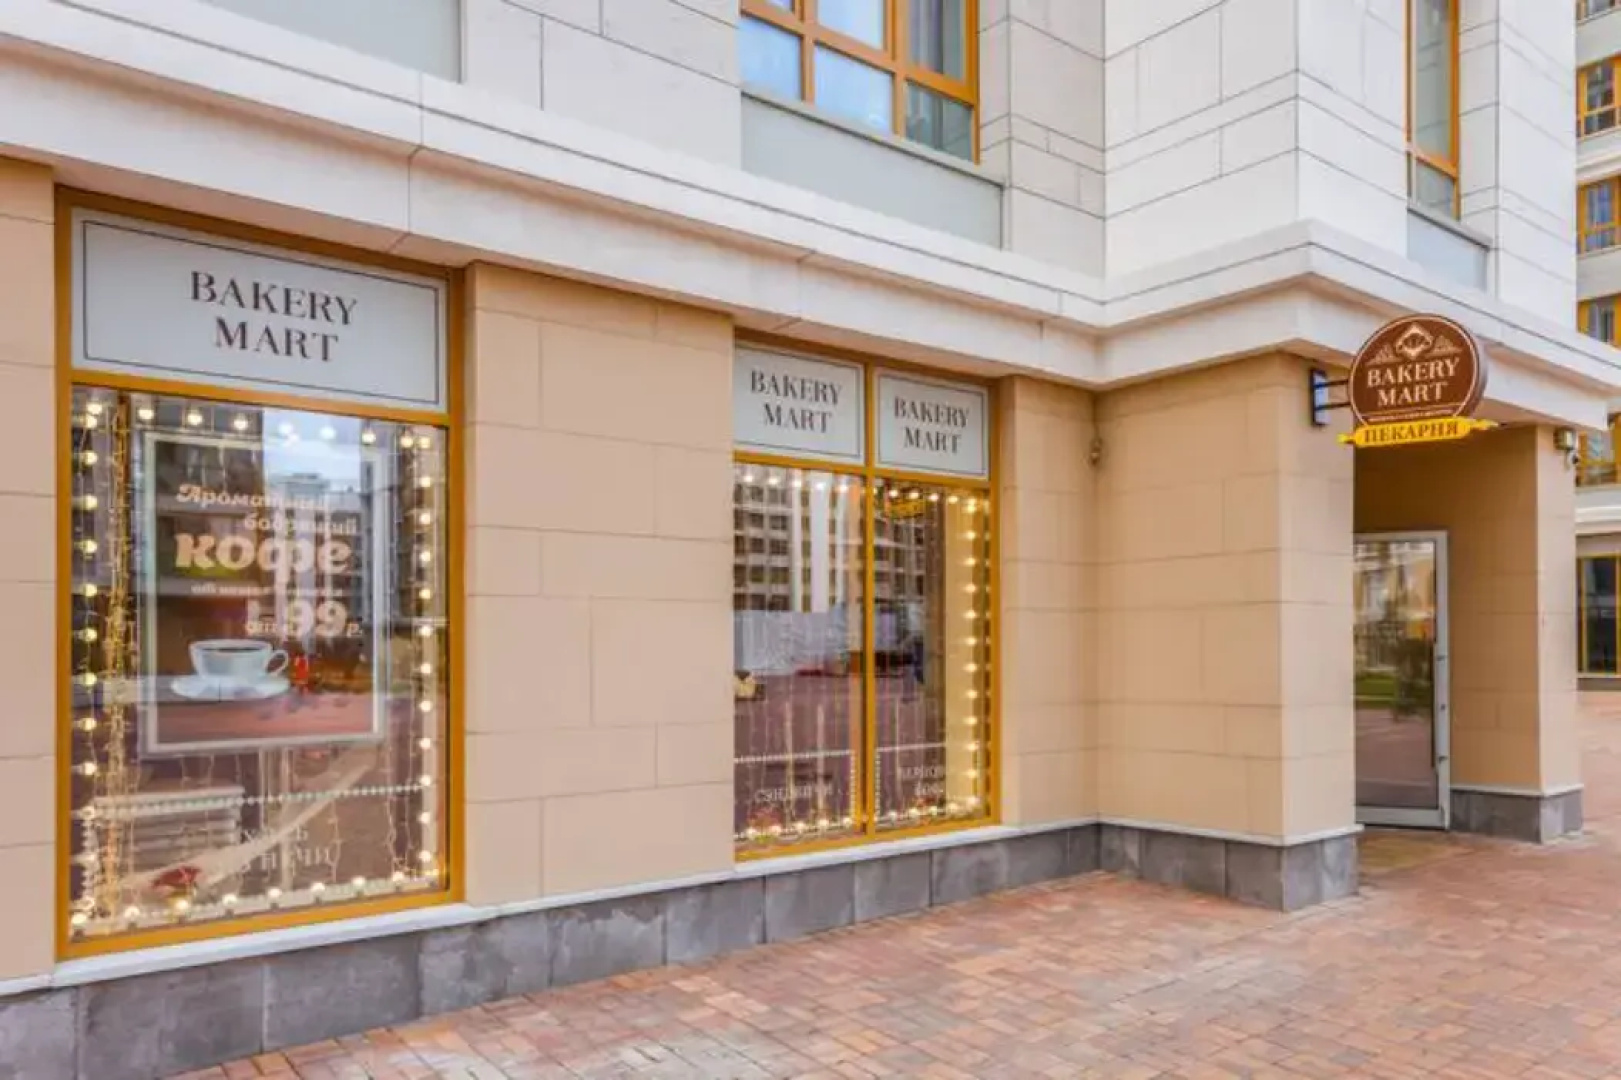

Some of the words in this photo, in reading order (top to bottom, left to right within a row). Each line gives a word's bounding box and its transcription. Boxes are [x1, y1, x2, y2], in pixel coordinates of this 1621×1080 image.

[190, 270, 358, 326] BAKERY
[214, 316, 339, 363] MART
[750, 369, 842, 406] BAKERY
[1367, 357, 1460, 388] BAKERY
[1377, 381, 1449, 407] MART
[763, 402, 833, 434] MART
[894, 395, 970, 429] BAKERY
[903, 426, 962, 455] MART
[1364, 421, 1458, 443] ПЕКАРНЯ
[175, 483, 327, 509] Аромат
